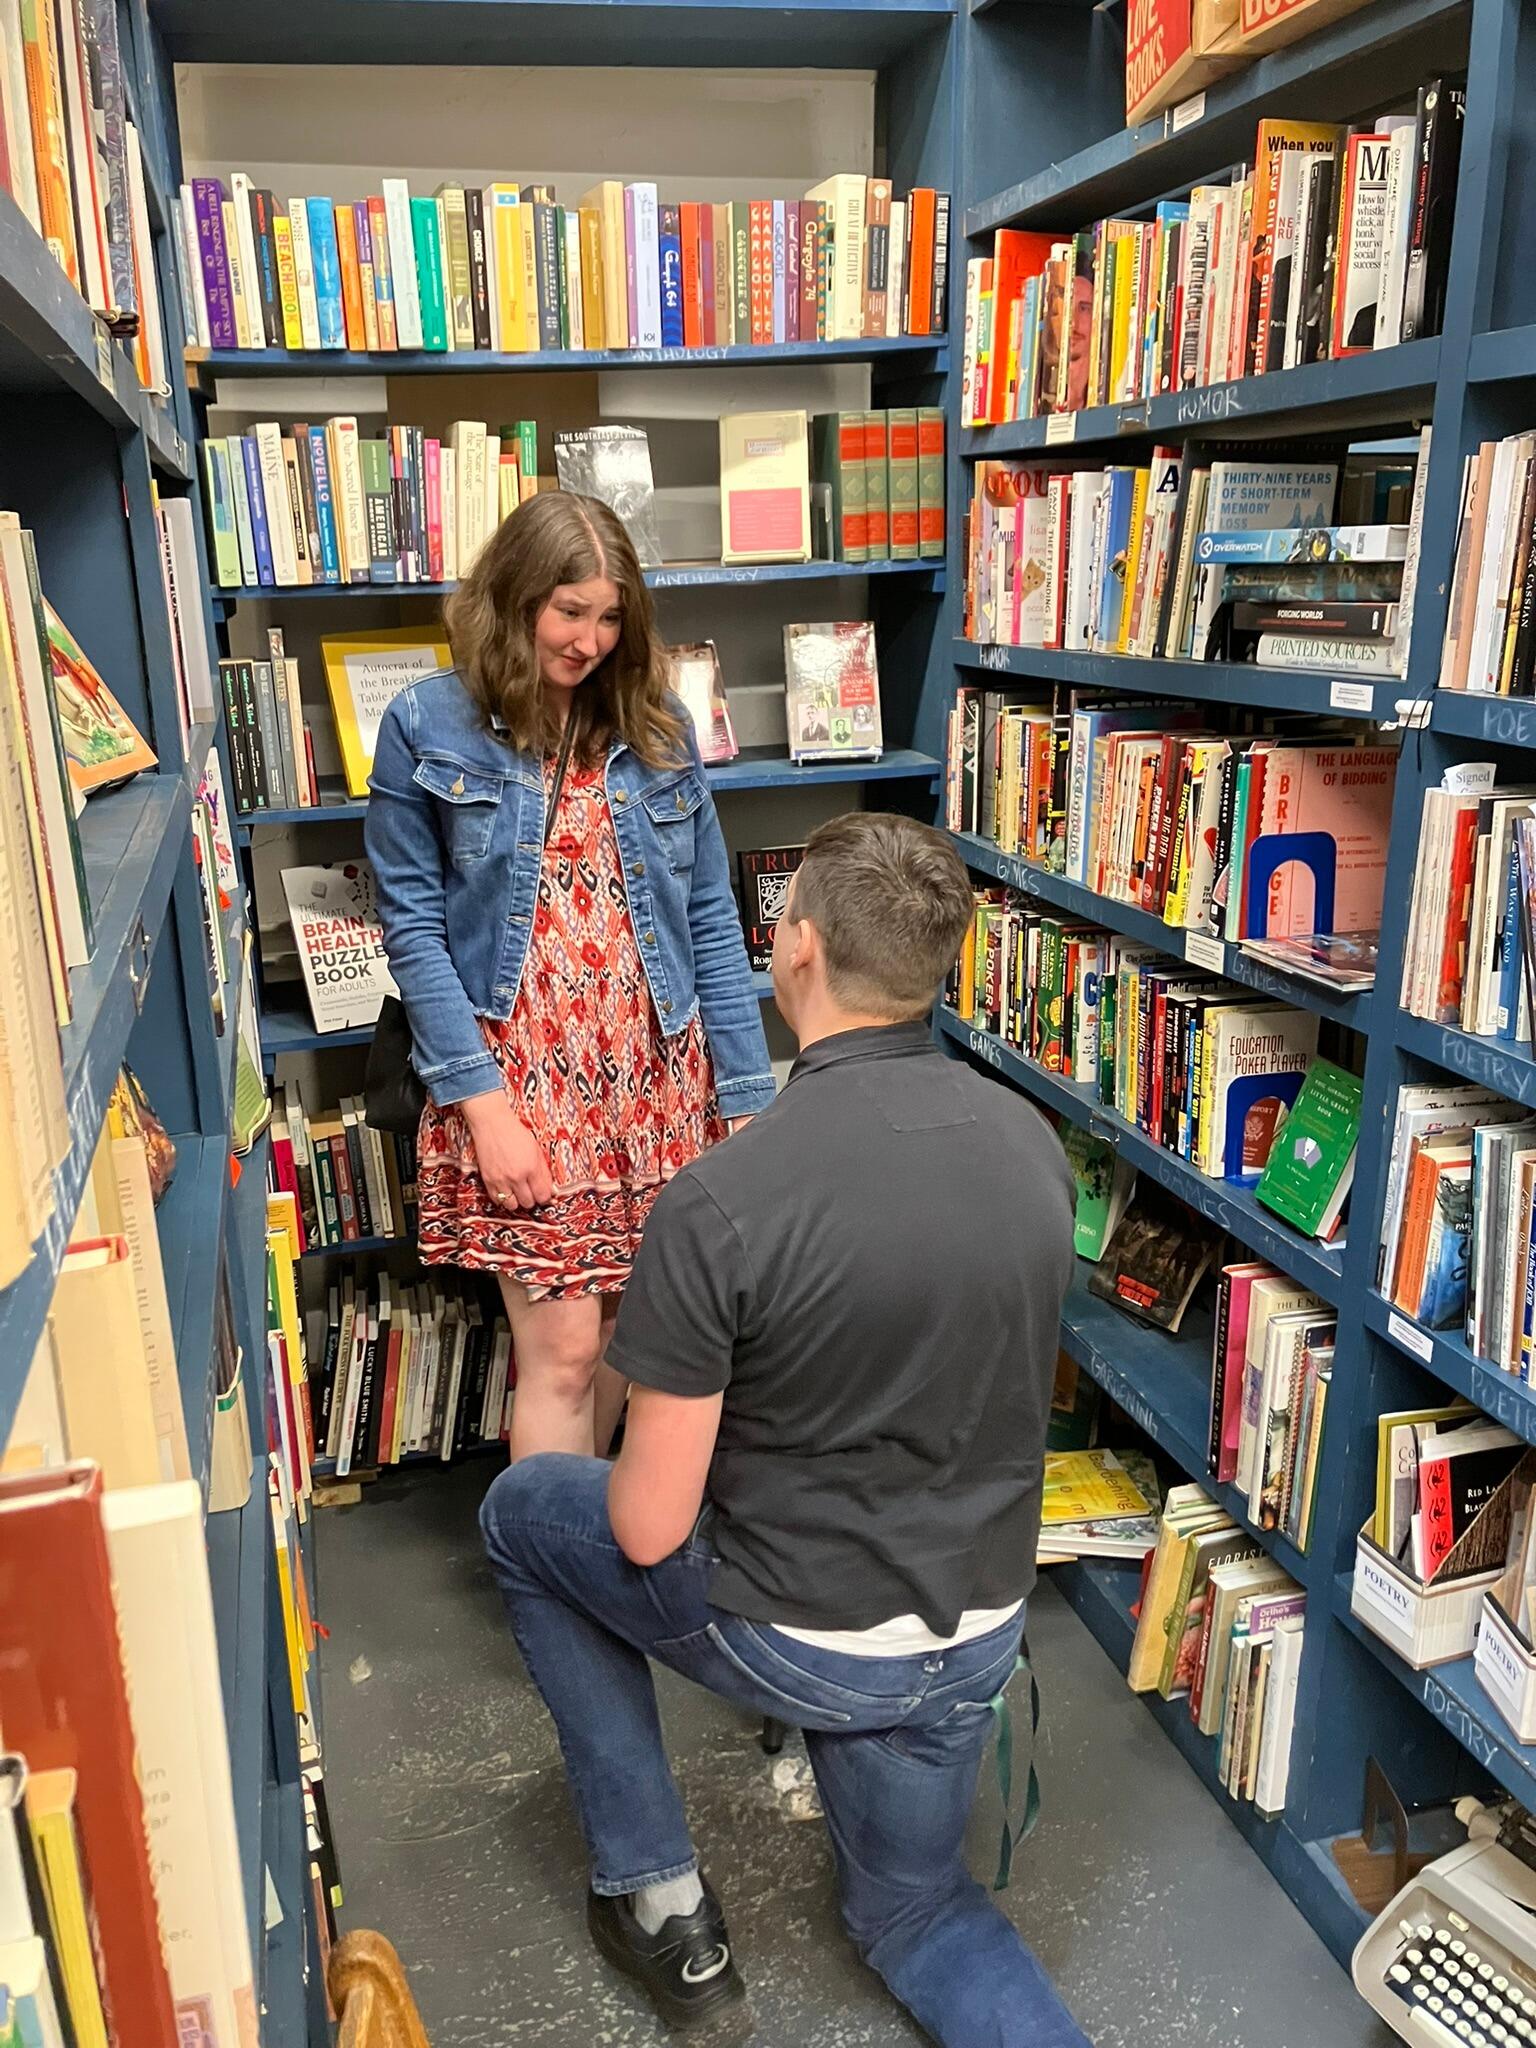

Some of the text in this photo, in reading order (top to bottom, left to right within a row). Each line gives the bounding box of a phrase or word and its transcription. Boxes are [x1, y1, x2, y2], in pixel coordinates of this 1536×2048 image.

[1268, 136, 1333, 152] When you
[1268, 151, 1280, 191] NEW
[209, 193, 219, 213] BELL
[1357, 194, 1385, 204] How to
[201, 220, 210, 236] Best
[211, 216, 223, 254] RINGING
[1355, 228, 1375, 238] honk
[472, 230, 483, 262] CHOICE
[1354, 239, 1373, 250] your
[1354, 249, 1376, 260] social
[716, 240, 726, 296] GARGOYLE
[802, 221, 818, 300] Gargoyle 74
[846, 231, 859, 285] DETECTIVES
[1353, 260, 1382, 270] success
[278, 235, 296, 322] BEACHBOOK
[219, 288, 230, 318] EMPTY
[666, 290, 678, 307] 64
[223, 320, 232, 337] SKY
[977, 302, 985, 348] FUNNY
[1178, 385, 1243, 421] HUMOR
[475, 433, 485, 450] The
[559, 432, 573, 443] THE
[263, 434, 278, 480] MAINE
[312, 435, 330, 502] NOVELLO
[464, 431, 475, 491] the Language
[475, 452, 485, 473] State
[343, 434, 359, 529] Our Sacred Honor
[1157, 465, 1180, 493] A
[1223, 472, 1332, 485] THIRTY-NINE YEARS
[1222, 487, 1311, 499] OF SHORT-TERM
[1221, 502, 1270, 515] MEMORY
[374, 498, 388, 556] AMERICAN
[1127, 484, 1140, 563] INSIDE COMEDY
[1220, 518, 1248, 530] LOSS
[1137, 523, 1151, 584] AMERICA
[1214, 543, 1263, 553] OVERWATCH
[655, 568, 759, 585] ANTHOLOGY
[1045, 572, 1053, 613] FINDING
[1521, 574, 1534, 628] CASSIAN
[1277, 610, 1324, 620] FORGING WORLDS
[1270, 638, 1378, 661] PRINTED SOURCES
[362, 658, 424, 674] Autocrat of
[360, 679, 378, 689] the
[358, 693, 388, 705] Table
[1483, 703, 1535, 743] POE
[1316, 751, 1399, 767] THE LANGUAG
[1323, 772, 1388, 786] OF BIDDING
[1456, 770, 1491, 786] Signed
[1151, 786, 1163, 831] POKER
[1223, 783, 1231, 824] BIGGEST
[1170, 784, 1190, 881] Bridge Dummies
[746, 851, 798, 872] TRU
[298, 903, 318, 913] THE
[300, 907, 348, 923] ULTIMATE
[302, 915, 366, 938] BRAIN
[1503, 887, 1518, 963] WASTE LAND
[305, 928, 384, 954] HEALTH
[310, 944, 387, 970] PUZZLE
[313, 962, 372, 986] BOOK
[985, 947, 995, 1006] POKER
[316, 978, 377, 997] FOR ADULTS
[1138, 1011, 1147, 1050] HIDING
[968, 1030, 1003, 1069] GAMES
[1230, 1034, 1284, 1056] EDUCATION
[1191, 1029, 1203, 1119] Texas Hold 'em
[1235, 1053, 1307, 1076] POKER PLAYER
[358, 1195, 368, 1223] GAIMAN
[1212, 1279, 1229, 1447] THE GARDEN DESIGN BOOK
[360, 1347, 376, 1423] LUCKY BLUE SMITH
[1471, 1366, 1536, 1440] POETR
[1088, 1452, 1137, 1512] Gardening
[1467, 1488, 1482, 1498] RED
[1363, 1564, 1410, 1610] POETRY
[1484, 1630, 1520, 1682] POETRY
[1424, 1677, 1499, 1767] POETRY
